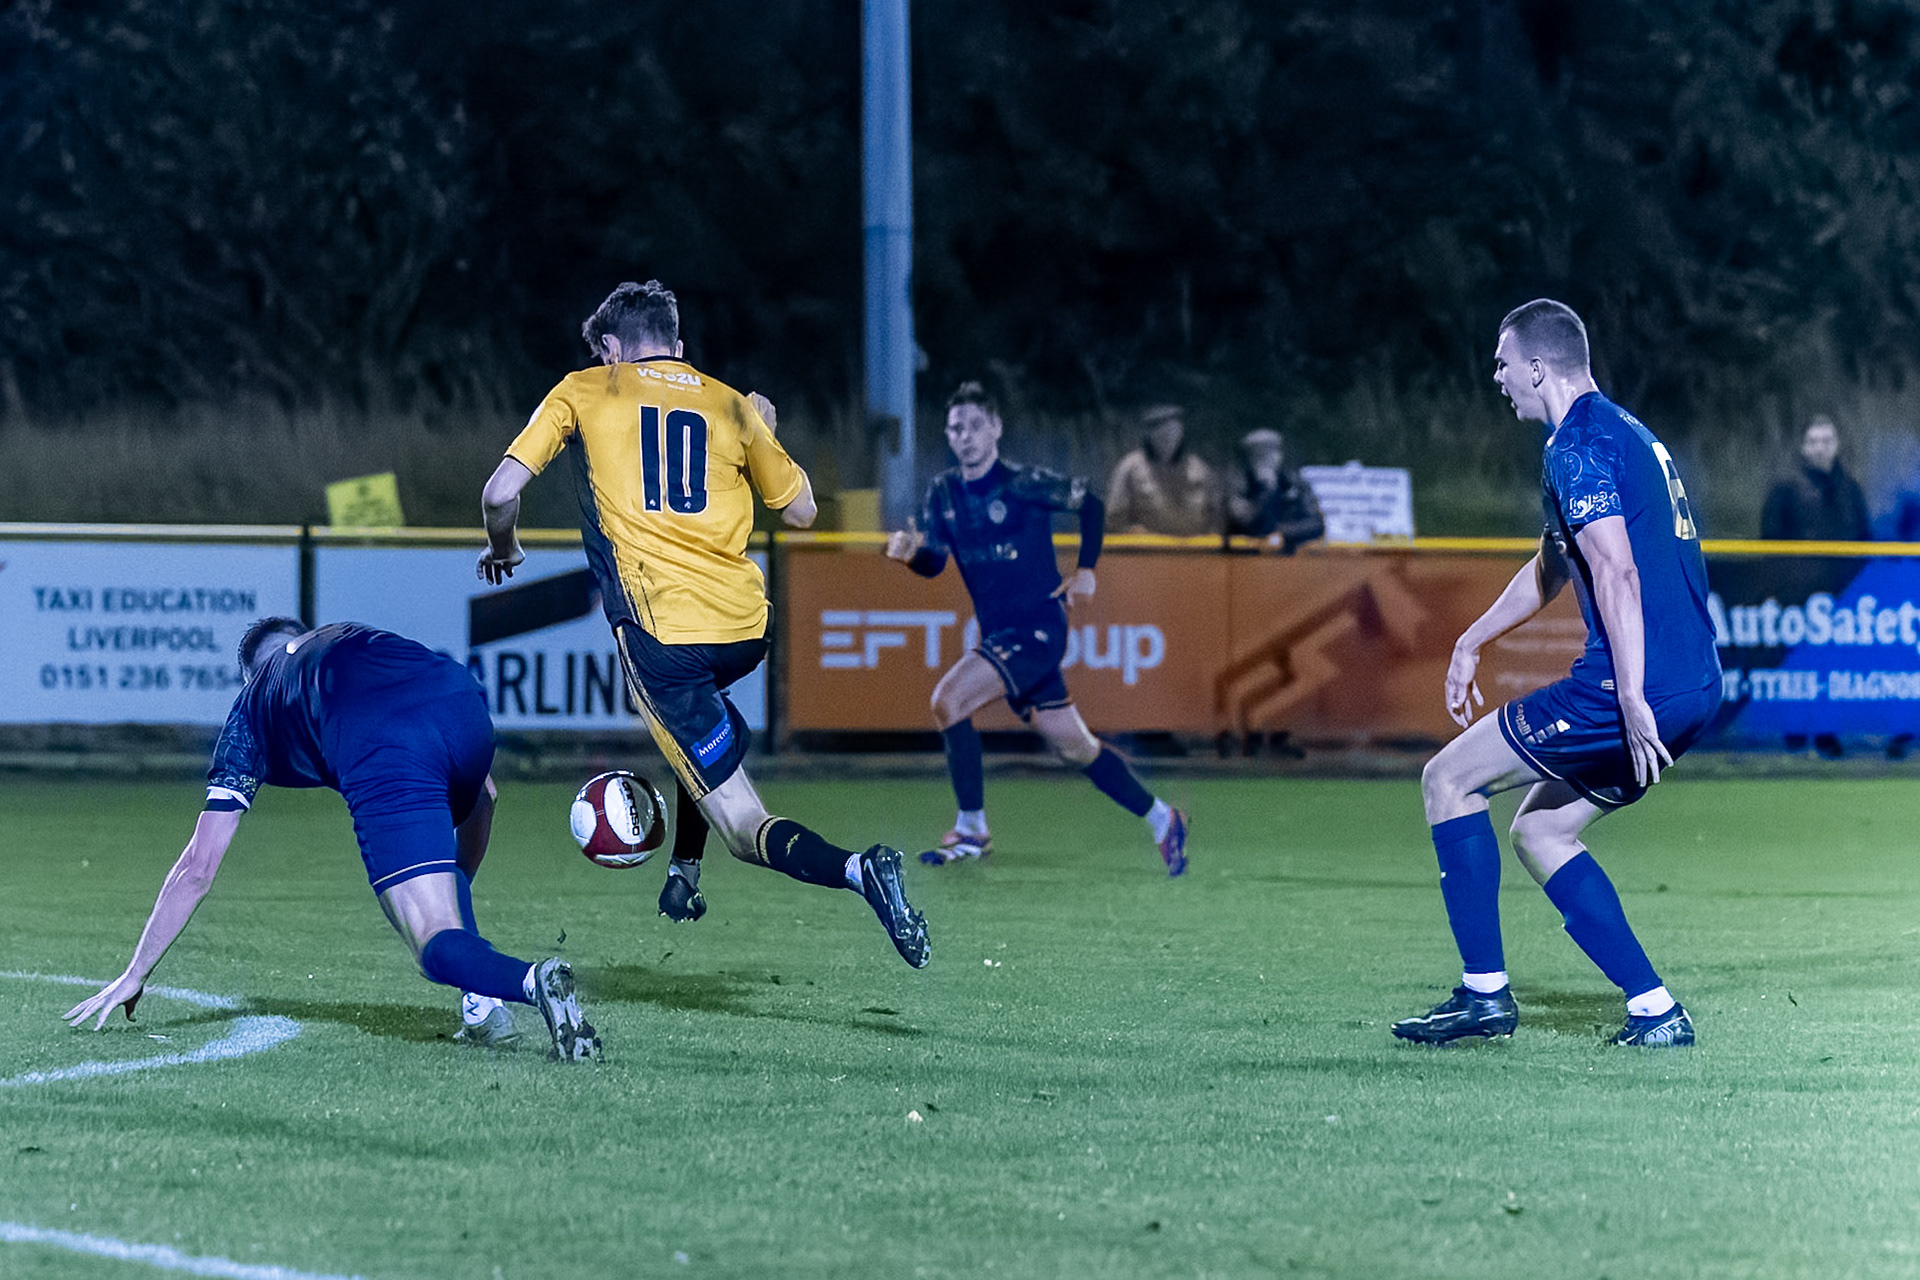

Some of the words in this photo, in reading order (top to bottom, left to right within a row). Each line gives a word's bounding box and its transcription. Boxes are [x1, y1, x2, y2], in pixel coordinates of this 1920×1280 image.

[639, 404, 708, 515] 10
[34, 587, 92, 612] TAXI
[102, 587, 256, 613] EDUCATION
[67, 627, 220, 651] LIVERPOOL
[821, 611, 957, 668] EFT
[1707, 592, 1920, 655] AutoSafet
[40, 664, 107, 689] 0151
